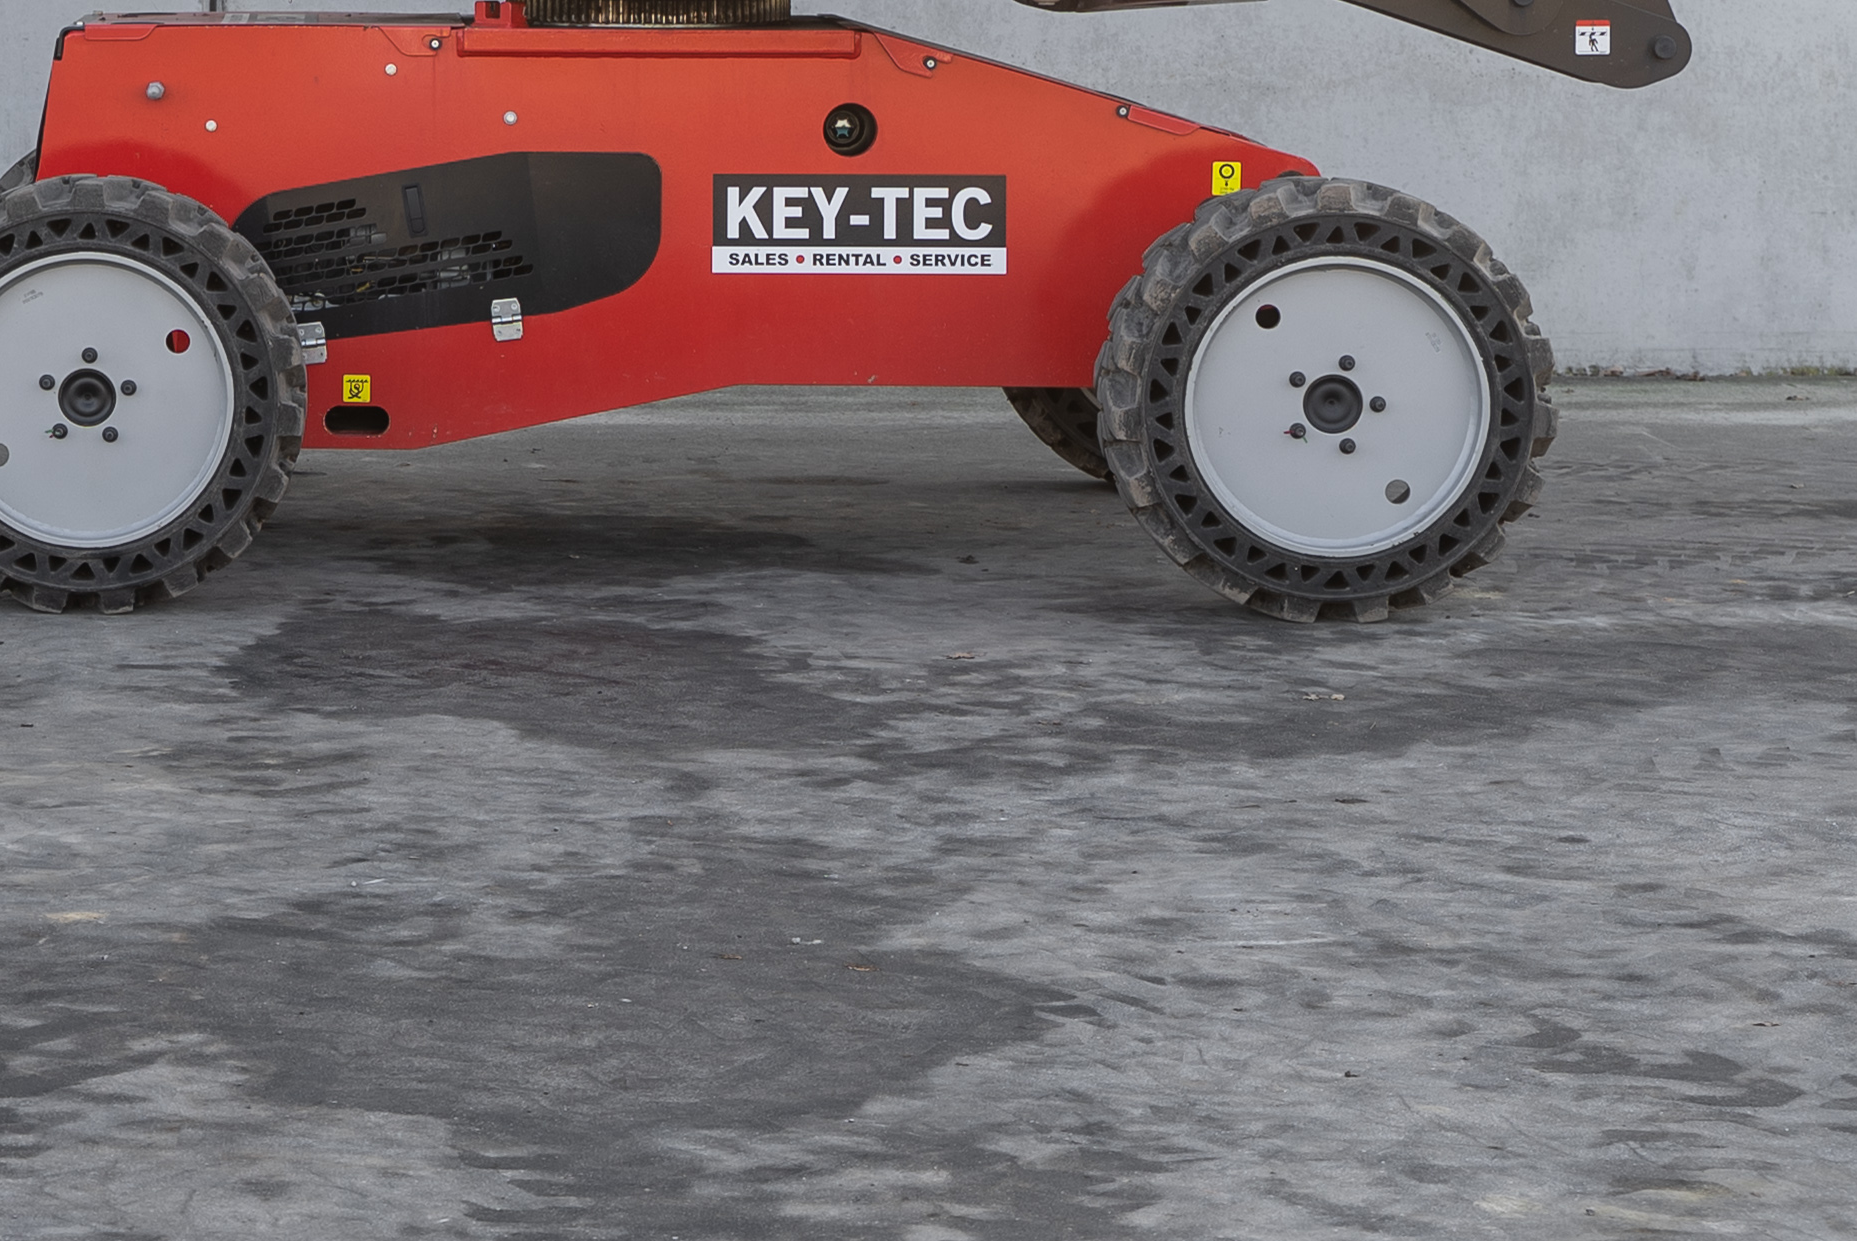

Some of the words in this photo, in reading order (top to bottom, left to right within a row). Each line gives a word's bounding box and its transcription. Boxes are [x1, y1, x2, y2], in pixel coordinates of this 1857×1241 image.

[725, 186, 994, 241] KEY-TEC
[728, 253, 789, 266] SALES
[812, 253, 887, 266] RENTAL
[909, 253, 992, 267] SERVICE
